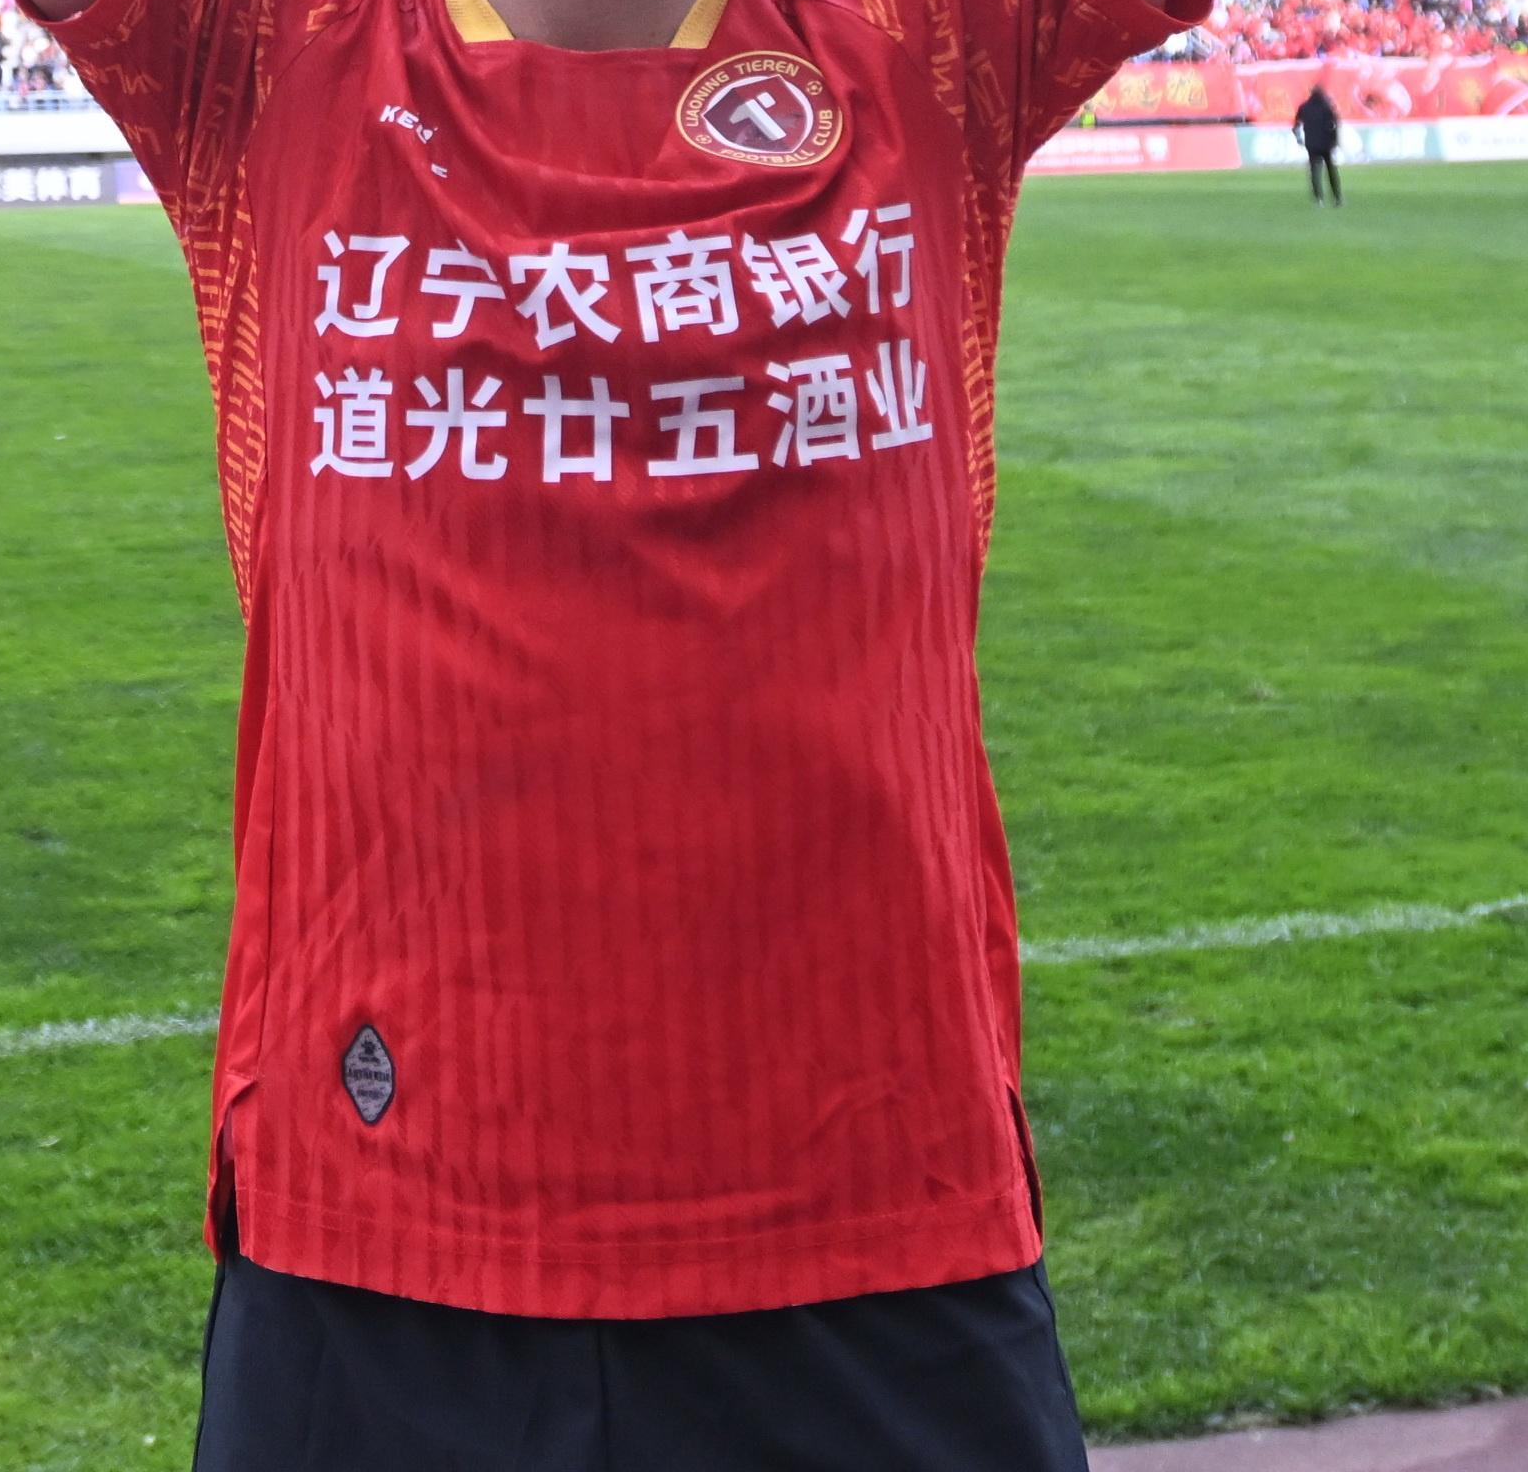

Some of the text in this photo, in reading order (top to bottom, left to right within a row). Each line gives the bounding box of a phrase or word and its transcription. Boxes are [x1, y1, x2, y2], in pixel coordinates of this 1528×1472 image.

[686, 59, 800, 127] LIAONING TIEREN
[720, 109, 833, 164] FOOTBALL CLUB
[314, 203, 916, 351] 辽宁农商银行
[310, 338, 934, 484] 道光廿五酒业
